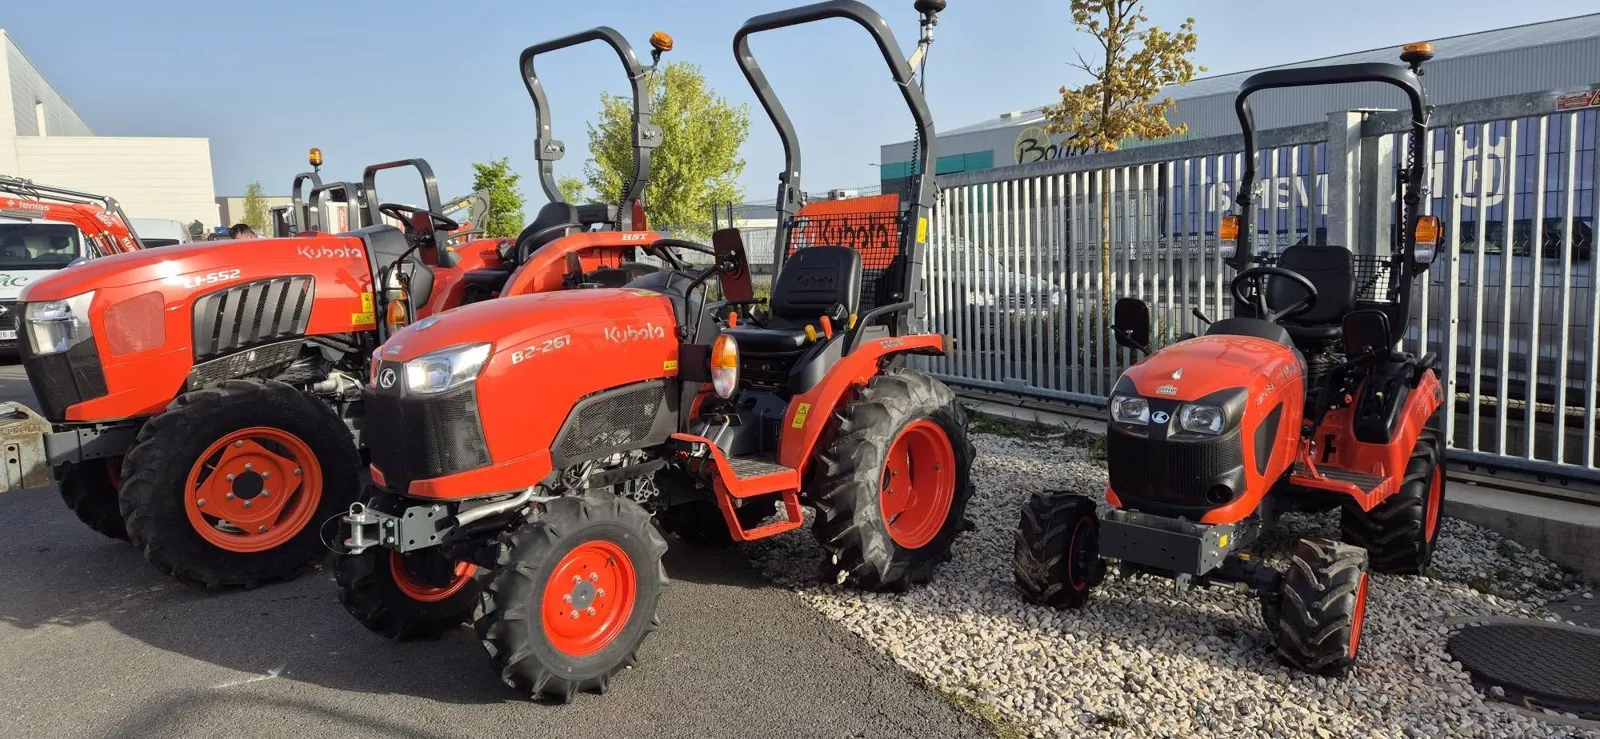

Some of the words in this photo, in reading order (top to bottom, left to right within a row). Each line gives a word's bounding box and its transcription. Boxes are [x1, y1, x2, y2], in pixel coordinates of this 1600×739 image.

[297, 245, 362, 259] Kubota
[604, 322, 665, 344] Kubota
[511, 334, 571, 365] B2-261
